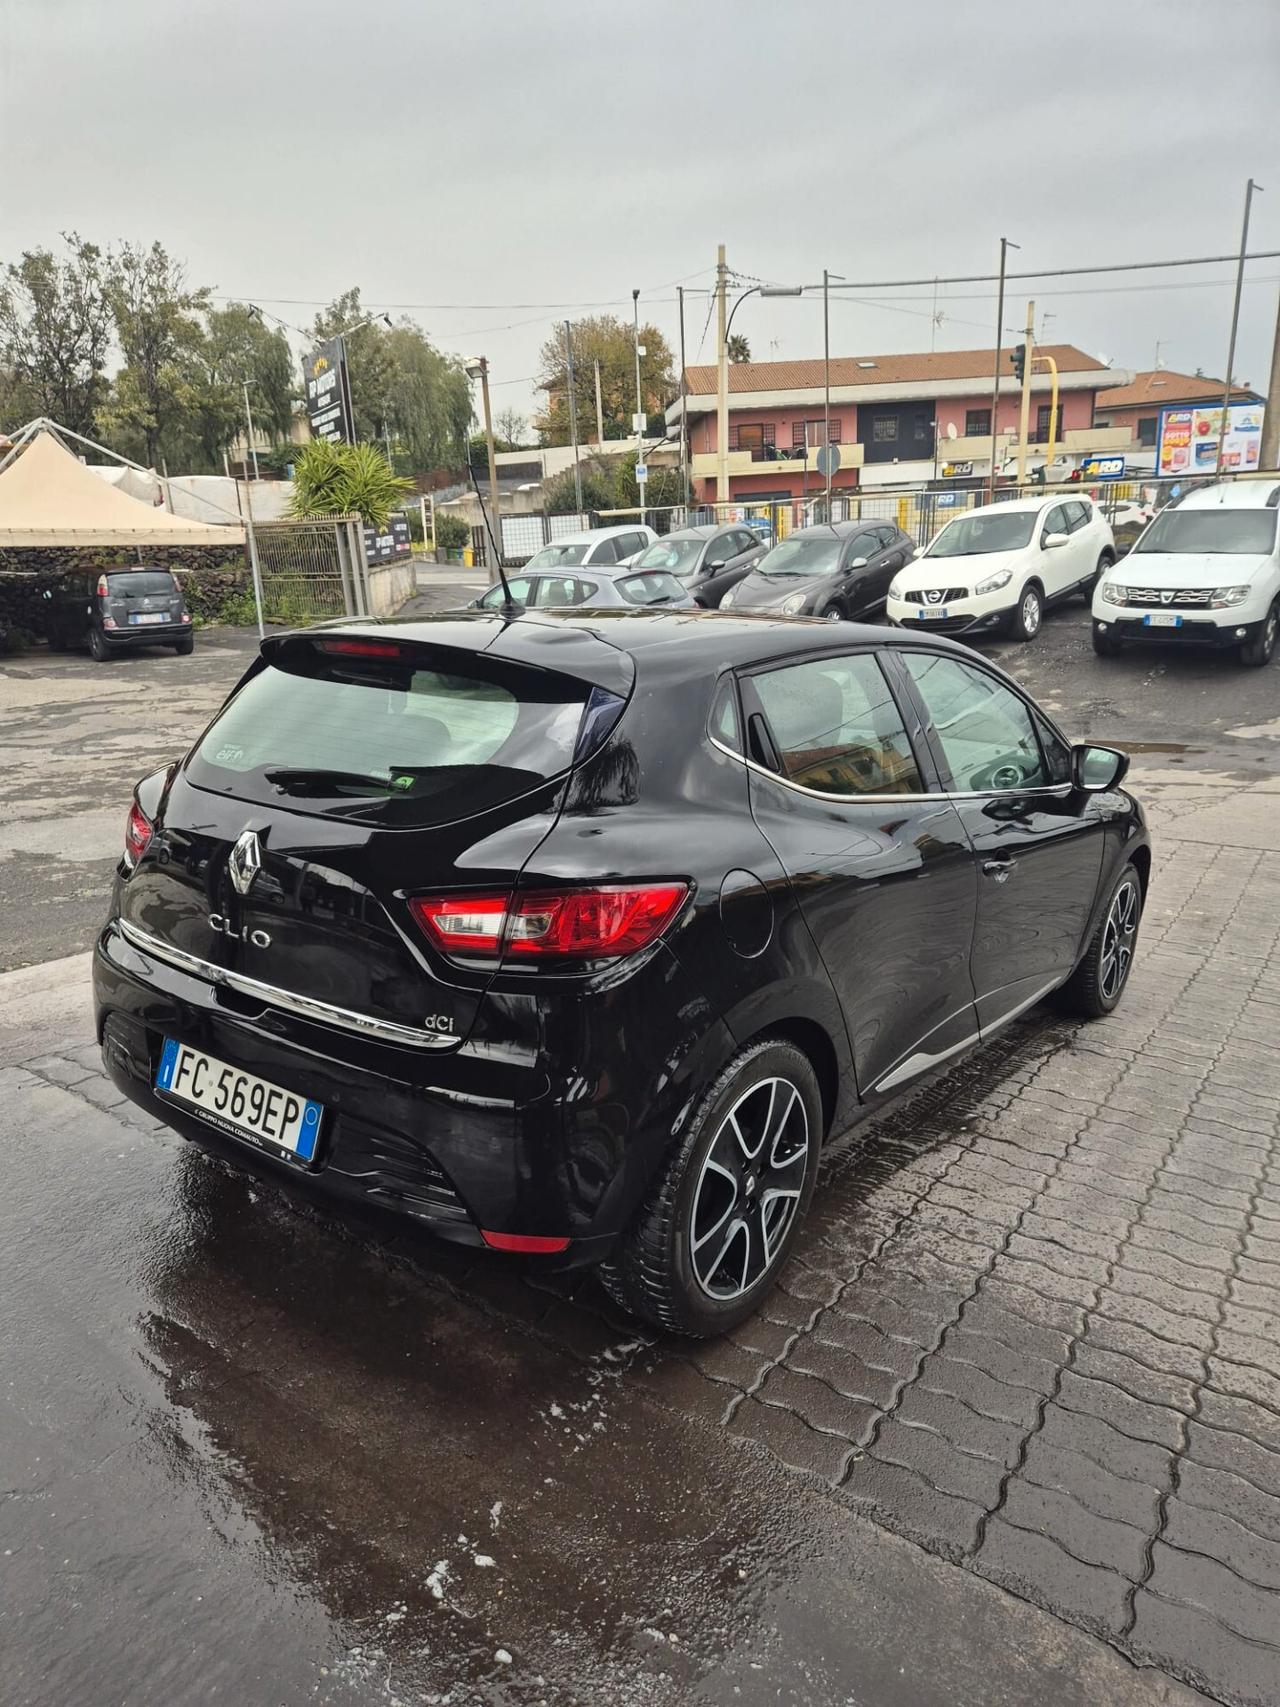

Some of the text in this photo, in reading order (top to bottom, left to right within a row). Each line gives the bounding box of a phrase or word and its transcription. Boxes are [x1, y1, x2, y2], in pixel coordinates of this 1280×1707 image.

[1168, 414, 1191, 423] ARD
[944, 464, 971, 475] ARD
[1086, 461, 1123, 475] ARD
[208, 913, 271, 949] CLIO
[174, 1049, 209, 1098] FC
[214, 1069, 300, 1140] 569EP
